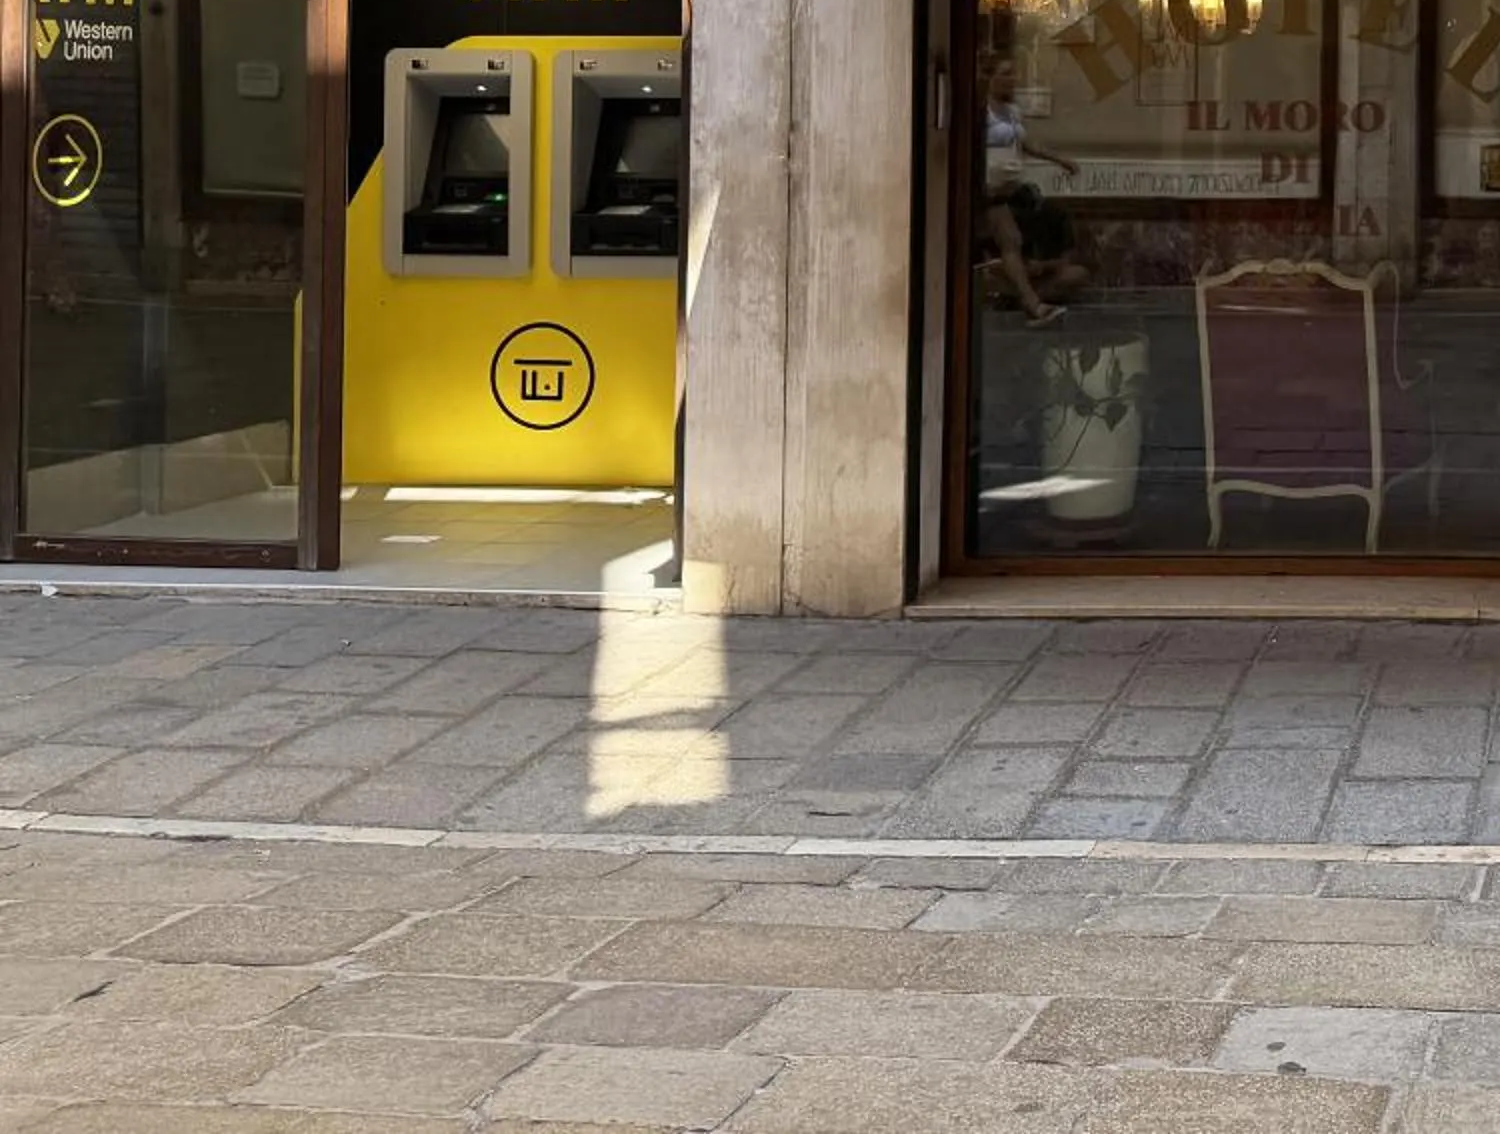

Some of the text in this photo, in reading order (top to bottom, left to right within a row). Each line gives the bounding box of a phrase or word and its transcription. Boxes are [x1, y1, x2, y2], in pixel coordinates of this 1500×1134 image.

[64, 19, 133, 41] Western
[63, 40, 113, 61] Union
[1185, 100, 1231, 132] IL
[1260, 150, 1311, 184] DI
